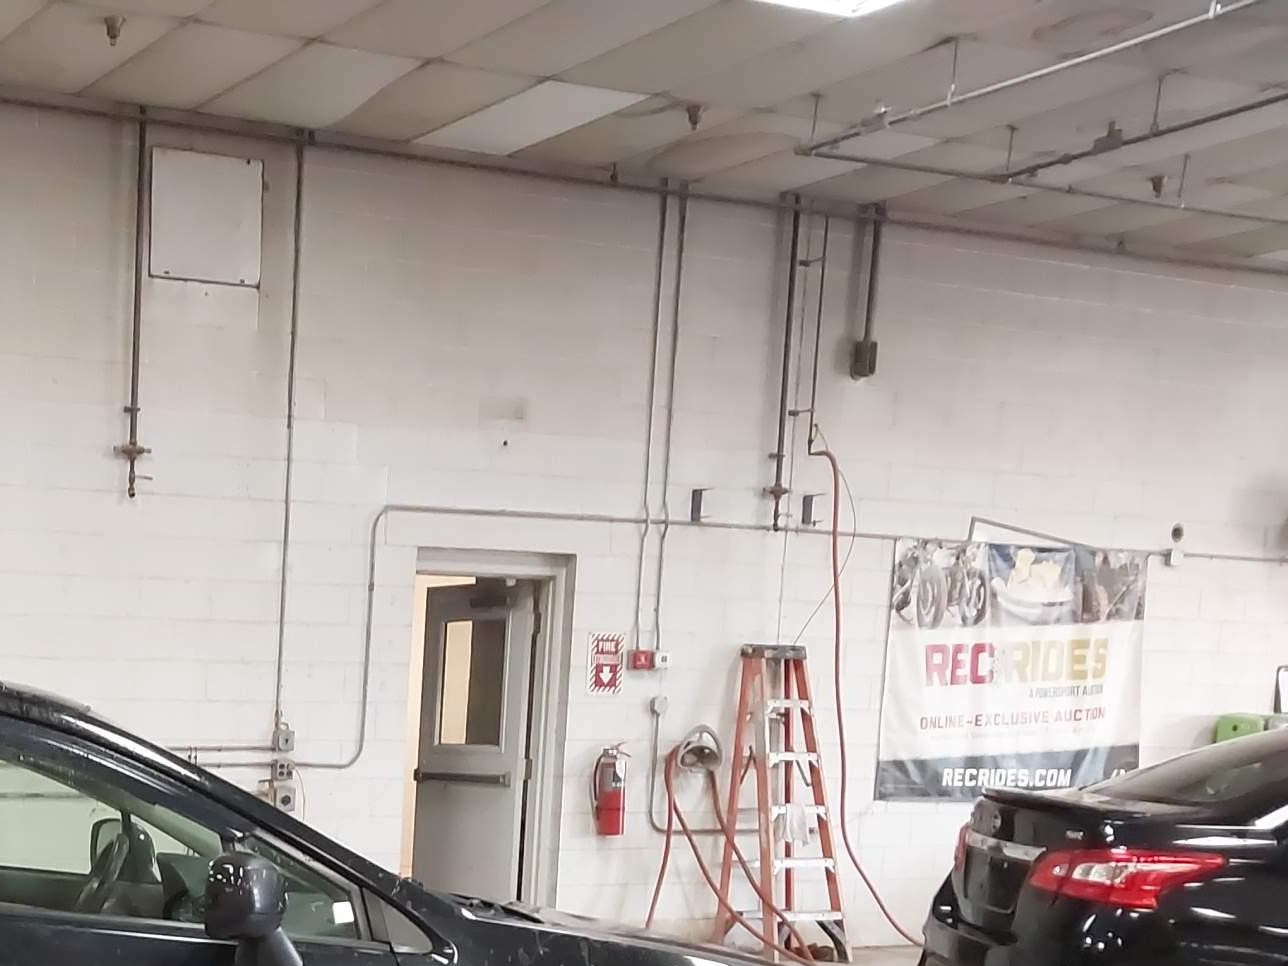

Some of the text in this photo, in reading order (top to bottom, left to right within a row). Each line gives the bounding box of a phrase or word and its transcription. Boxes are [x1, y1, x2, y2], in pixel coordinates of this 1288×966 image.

[598, 640, 616, 652] FIRE
[920, 706, 1106, 730] ONLINE-EXCLUSIVE AUCTION
[942, 767, 1073, 788] RECRIDES.COM
